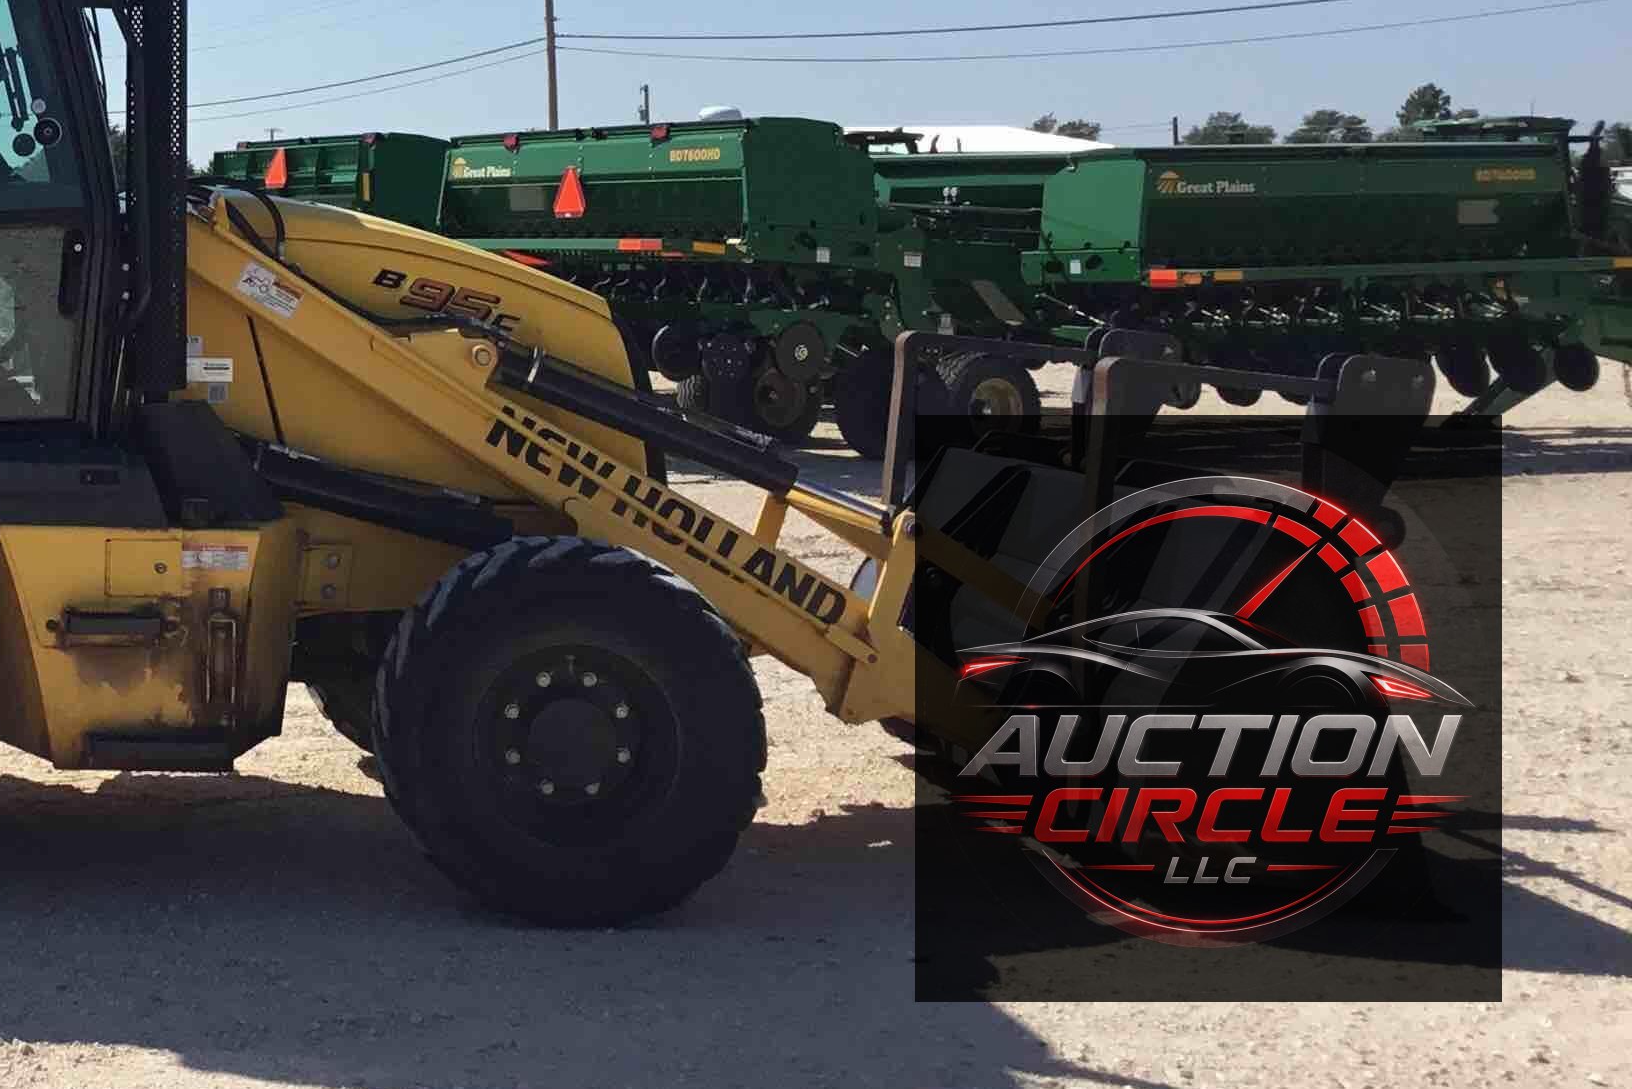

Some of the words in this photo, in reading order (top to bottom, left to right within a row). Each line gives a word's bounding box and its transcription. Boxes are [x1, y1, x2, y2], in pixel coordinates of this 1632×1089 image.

[463, 165, 486, 179] Great
[486, 164, 512, 178] Plains
[1176, 180, 1215, 193] Great
[1215, 179, 1256, 193] Plains
[484, 404, 617, 500] NEW
[612, 474, 847, 625] HOLLAND
